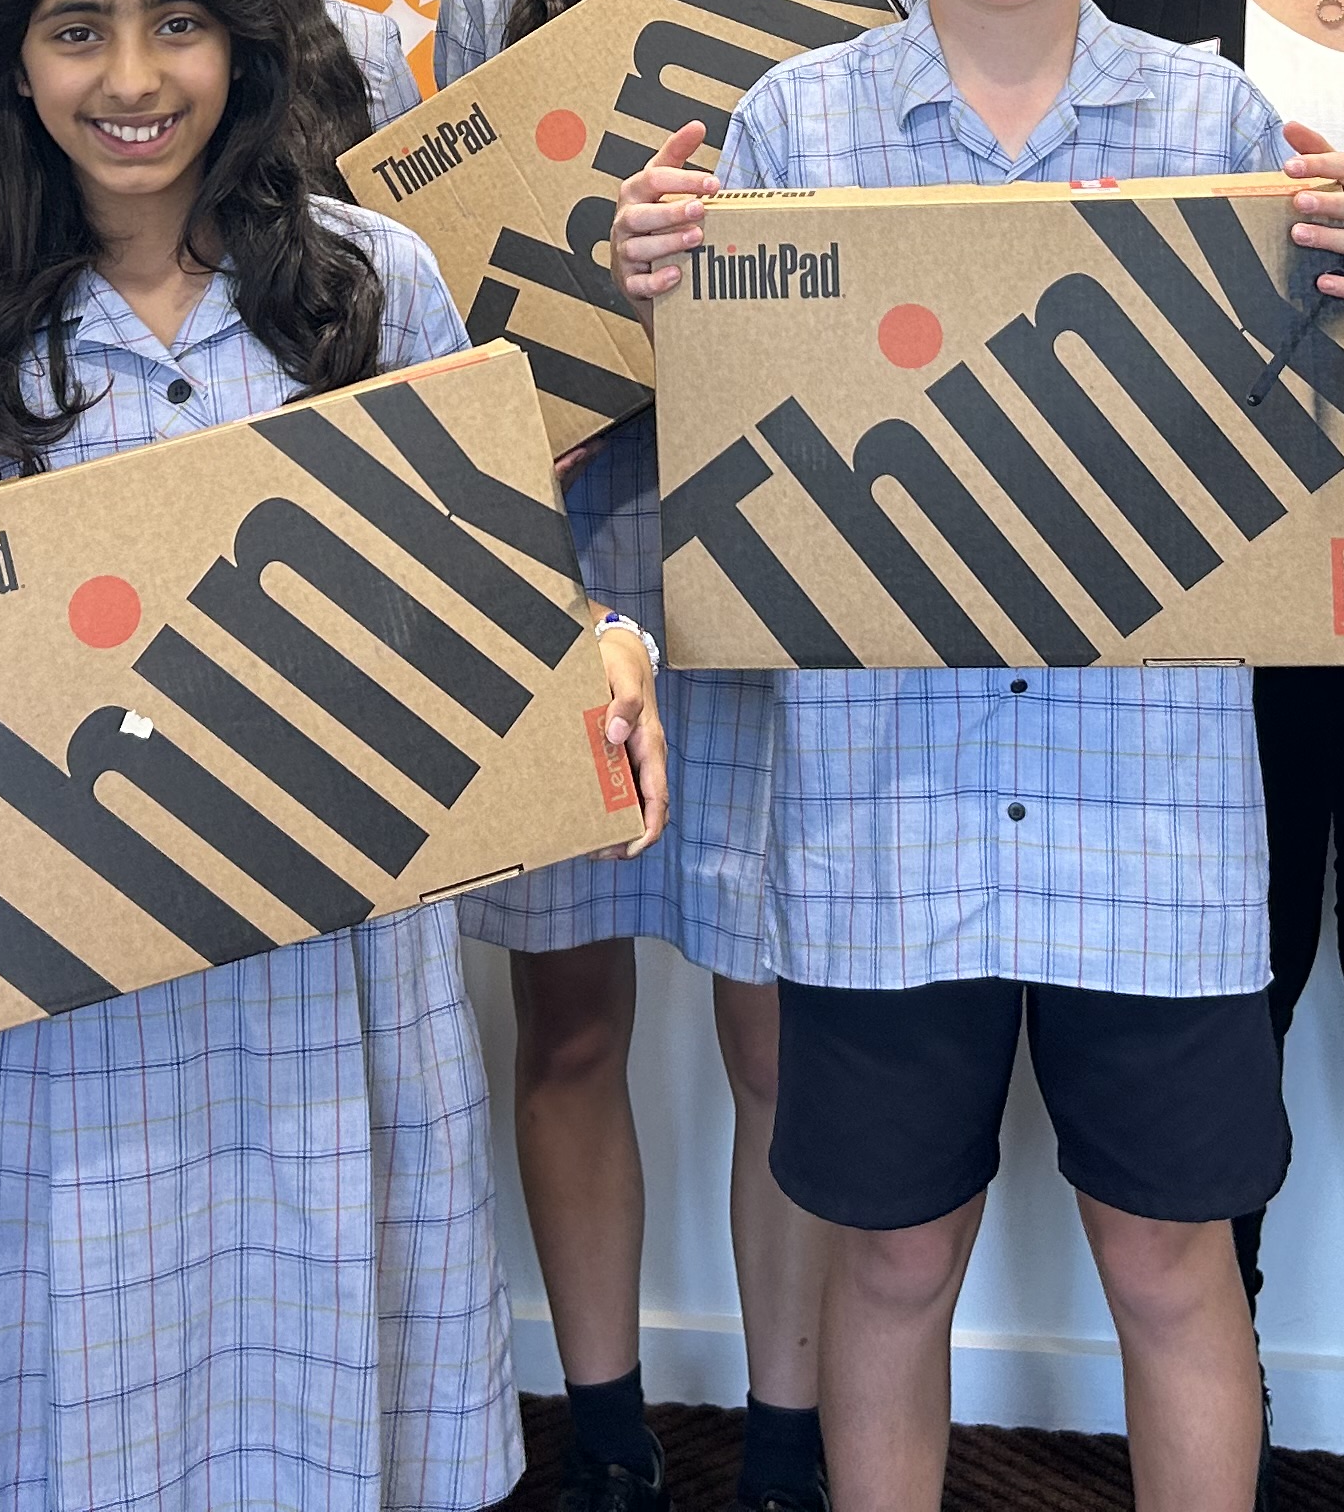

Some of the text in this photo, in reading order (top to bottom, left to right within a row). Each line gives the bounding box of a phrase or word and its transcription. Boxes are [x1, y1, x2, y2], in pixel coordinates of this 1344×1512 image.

[372, 102, 497, 203] ThinkPad
[690, 241, 840, 301] ThinkPad
[597, 714, 629, 802] Leno
